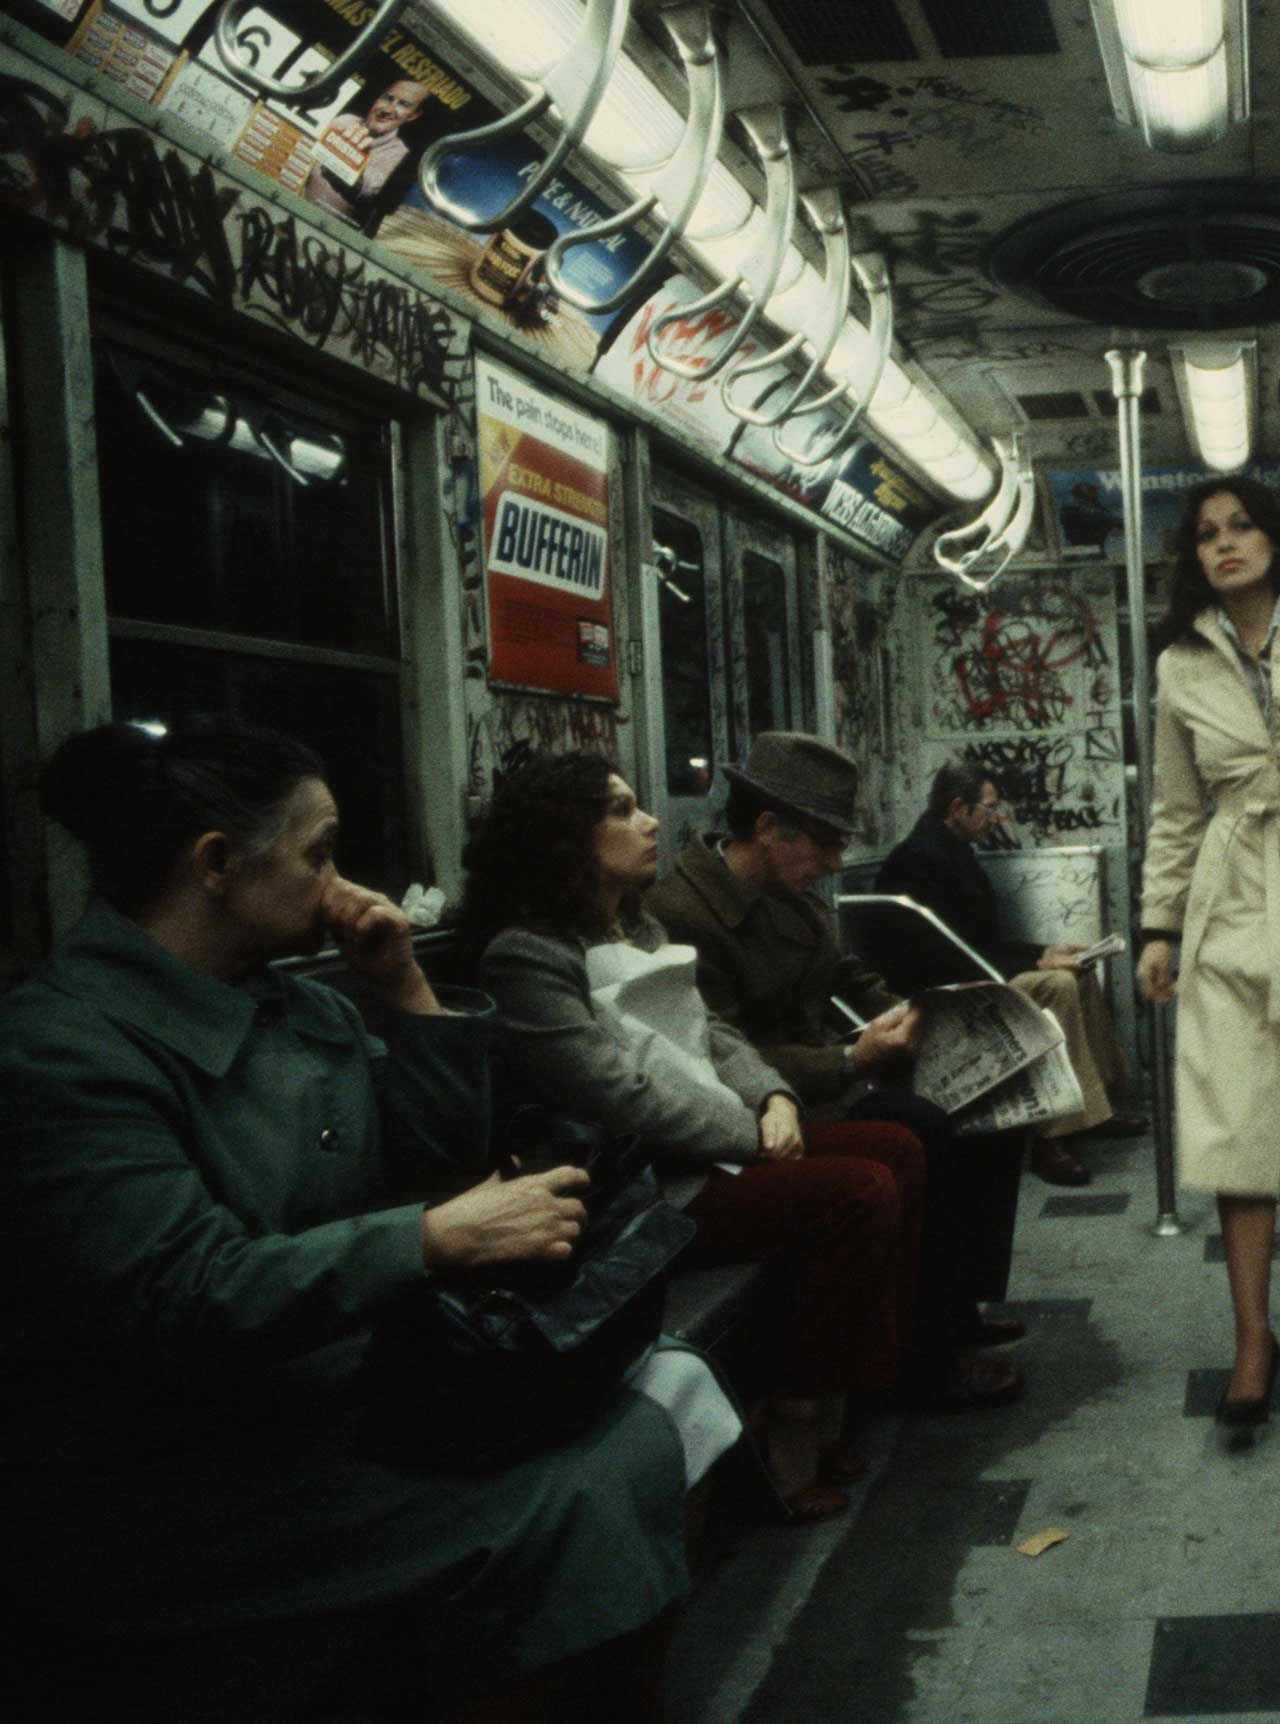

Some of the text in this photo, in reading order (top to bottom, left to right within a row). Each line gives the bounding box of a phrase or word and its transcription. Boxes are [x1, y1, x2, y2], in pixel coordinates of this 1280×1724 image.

[487, 376, 513, 410] The
[516, 398, 542, 425] pain
[544, 410, 573, 440] stops
[507, 463, 552, 498] EXTRA
[1096, 470, 1209, 492] Wnsto
[496, 501, 603, 590] BUFFERIN
